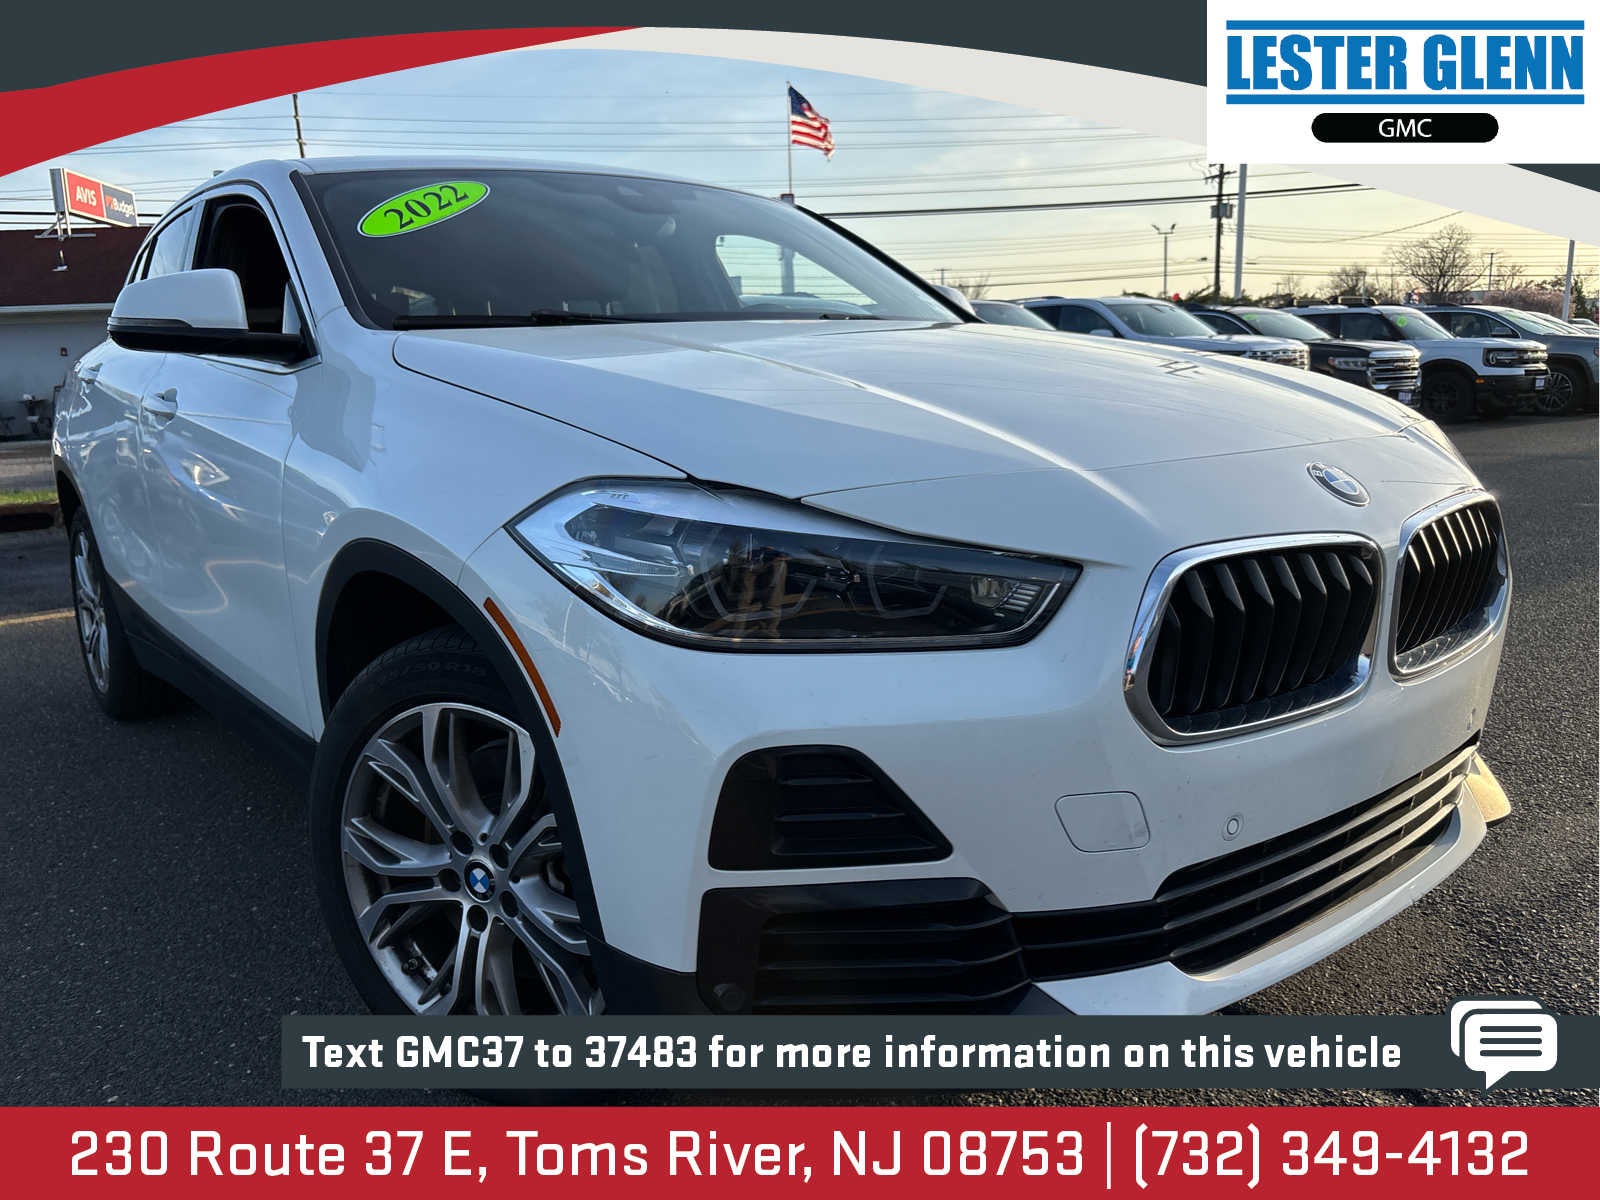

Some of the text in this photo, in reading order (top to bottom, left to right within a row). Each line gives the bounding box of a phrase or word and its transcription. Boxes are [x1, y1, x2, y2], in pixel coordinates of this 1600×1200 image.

[75, 185, 97, 206] AVIS
[112, 197, 135, 217] Budget
[384, 186, 469, 229] 2022
